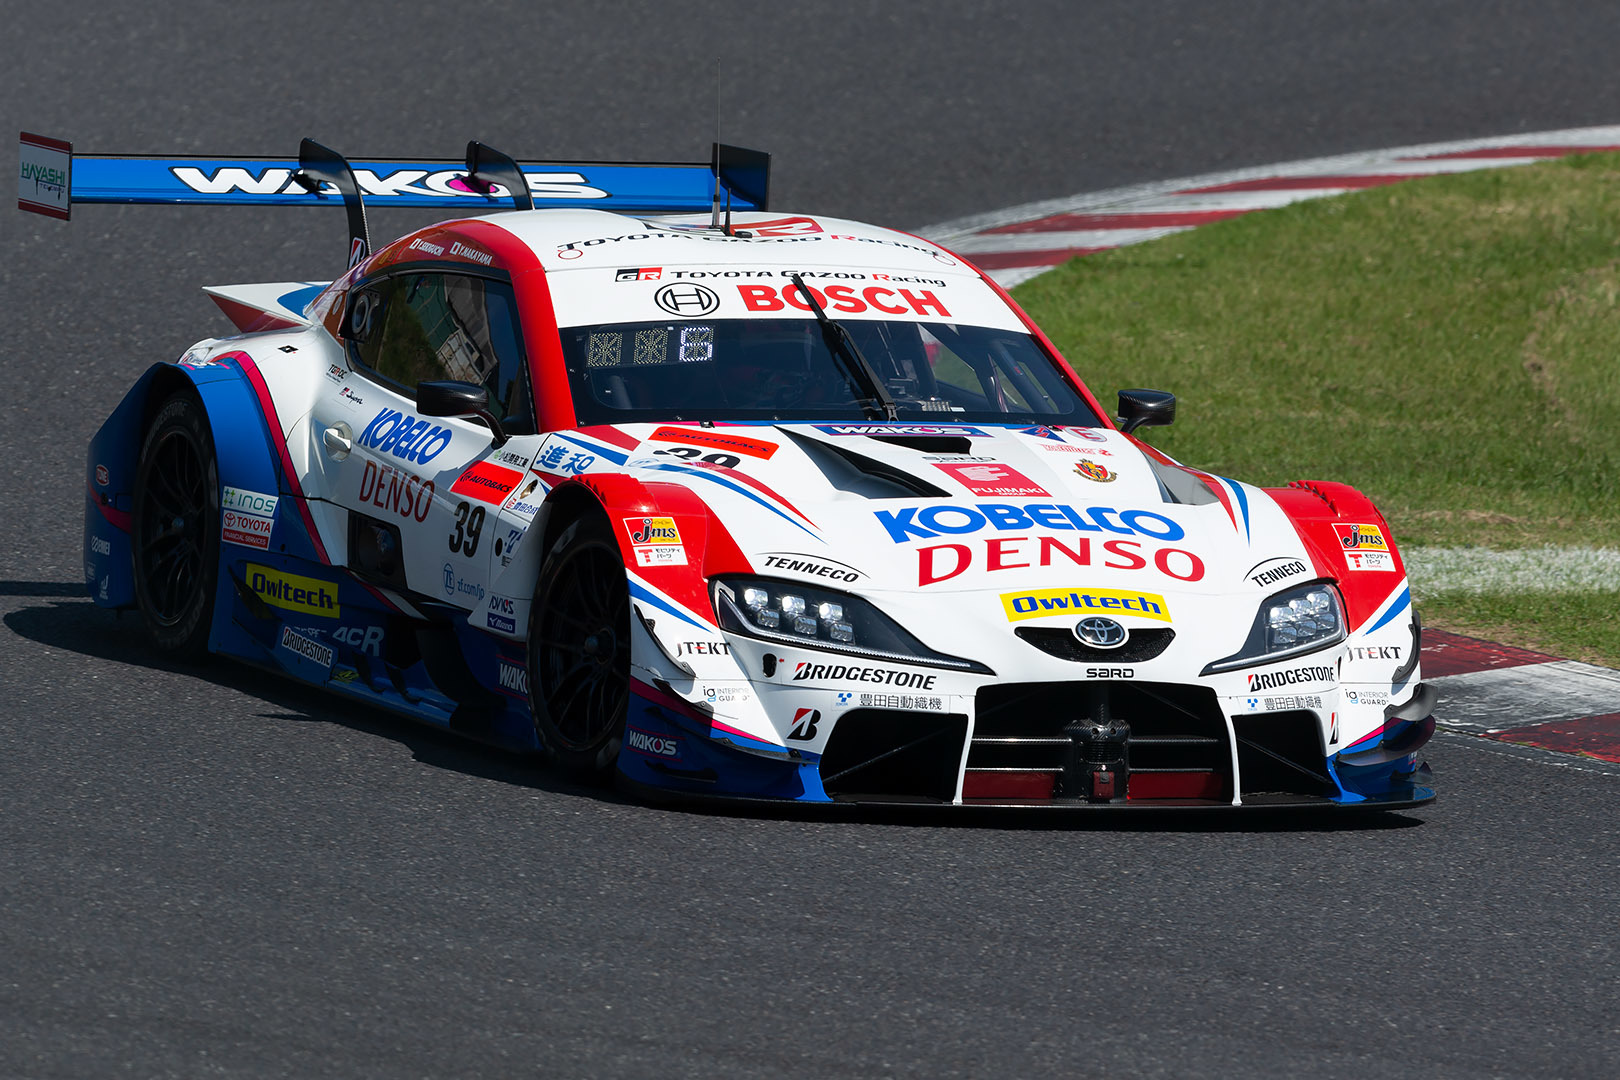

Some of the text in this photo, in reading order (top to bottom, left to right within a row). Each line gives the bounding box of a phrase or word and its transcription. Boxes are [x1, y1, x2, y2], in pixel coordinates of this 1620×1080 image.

[21, 162, 66, 184] HAYASHI
[670, 270, 773, 279] TOYOTA
[780, 270, 866, 280] GAZOO
[872, 273, 947, 287] Racing
[737, 284, 953, 318] BOSCH
[357, 407, 453, 465] KOBELCO
[535, 444, 597, 475] 進和
[359, 459, 435, 523] DENSO
[469, 475, 513, 493] AUTOBACS
[237, 516, 271, 534] TOYOTA
[449, 501, 486, 558] 39
[633, 518, 676, 543] jms
[873, 504, 1185, 544] KOBELCO
[1343, 524, 1383, 548] jms
[764, 556, 859, 583] TENNECO
[917, 536, 1206, 587] DENSO
[1251, 561, 1307, 588] TENNECO
[252, 573, 334, 609] Owltech
[1012, 593, 1162, 615] Owltech
[283, 627, 333, 667] BRIDGESTONE
[676, 641, 731, 657] JTEKT
[1347, 646, 1401, 662] JTEKT
[792, 662, 937, 690] BRIDGESTONE
[1248, 666, 1336, 692] BRIDGESTONE
[1358, 691, 1389, 699] INTERIOR
[1360, 698, 1388, 706] GUARD
